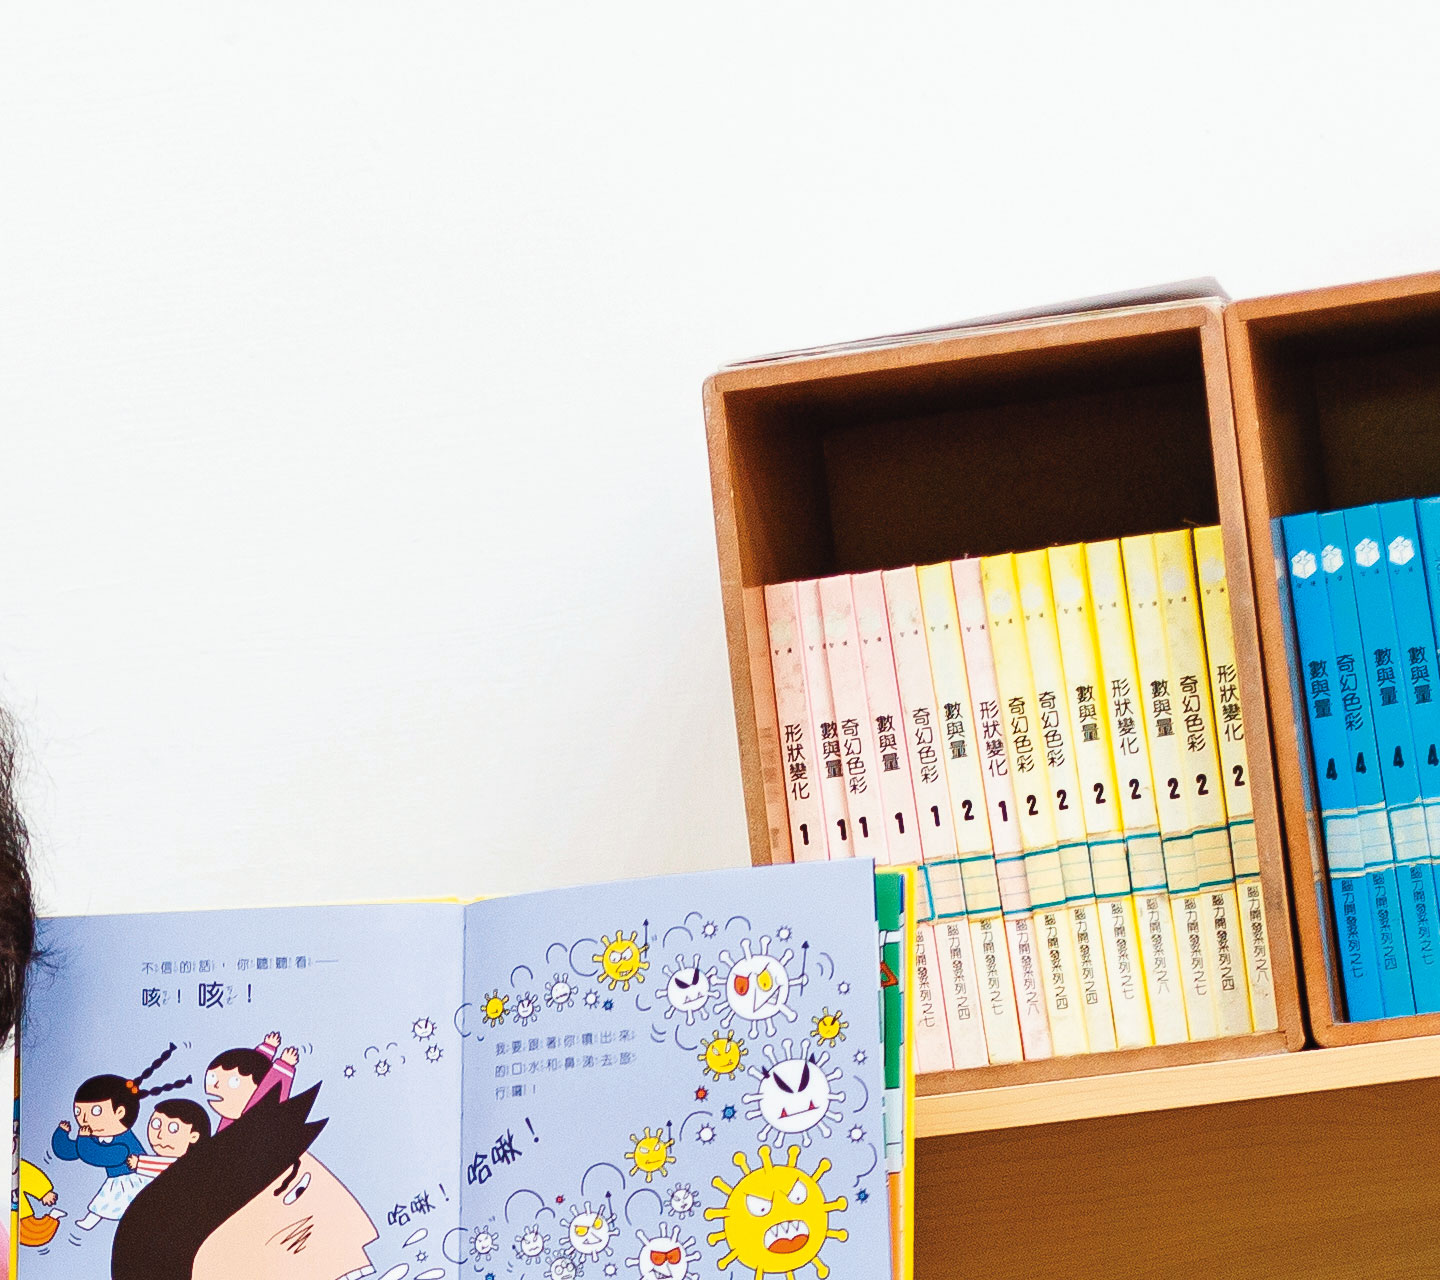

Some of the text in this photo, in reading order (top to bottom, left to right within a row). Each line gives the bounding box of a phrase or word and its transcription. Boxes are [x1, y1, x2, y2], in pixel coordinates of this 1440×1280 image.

[943, 701, 974, 821] 數與量 2
[980, 700, 1008, 821] 形狀變化 1
[1009, 696, 1038, 816] 奇幻色彩 2
[1039, 691, 1068, 810] 奇幻色彩 2
[1075, 685, 1106, 804] 數與量 2
[1112, 678, 1141, 800] 形狀變化 2
[1150, 679, 1180, 799] 數與量 2
[1180, 675, 1209, 795] 奇幻色彩 2
[1217, 664, 1245, 786] 形狀變化 2
[1308, 660, 1337, 781] 數與量 4
[1336, 654, 1367, 774] 奇幻色彩 4
[1374, 648, 1404, 768] 數與量 4
[1408, 646, 1439, 766] 數與量 4
[785, 723, 809, 845] 形狀變化 1
[820, 721, 847, 840] 數與量 1
[841, 718, 868, 838] 奇幻色彩 1
[876, 715, 905, 834] 數與量 1
[913, 707, 940, 826] 奇幻色彩 1
